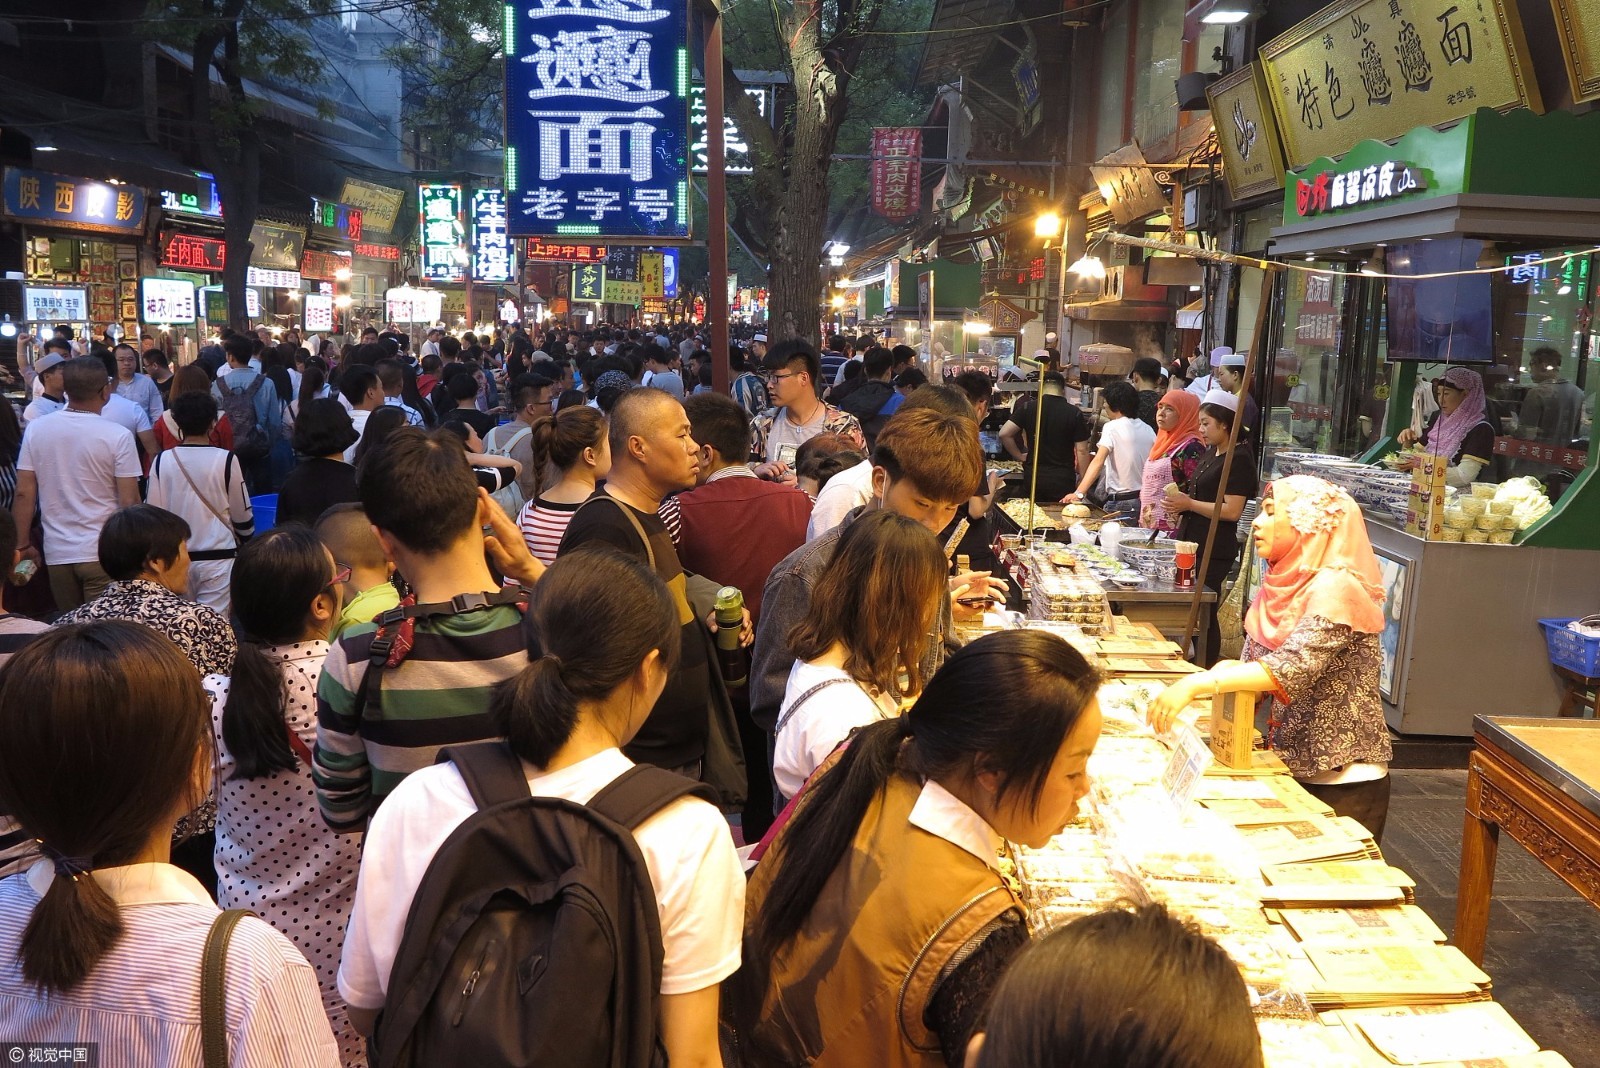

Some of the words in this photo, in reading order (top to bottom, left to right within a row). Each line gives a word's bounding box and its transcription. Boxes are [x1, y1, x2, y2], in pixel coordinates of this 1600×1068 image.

[884, 147, 910, 210] 正宗肉夹馍
[521, 186, 675, 221] 老字号
[477, 202, 509, 277] 牛羊肉泡馍
[532, 244, 591, 258] 上的中国
[146, 296, 192, 319] 神农小土豆
